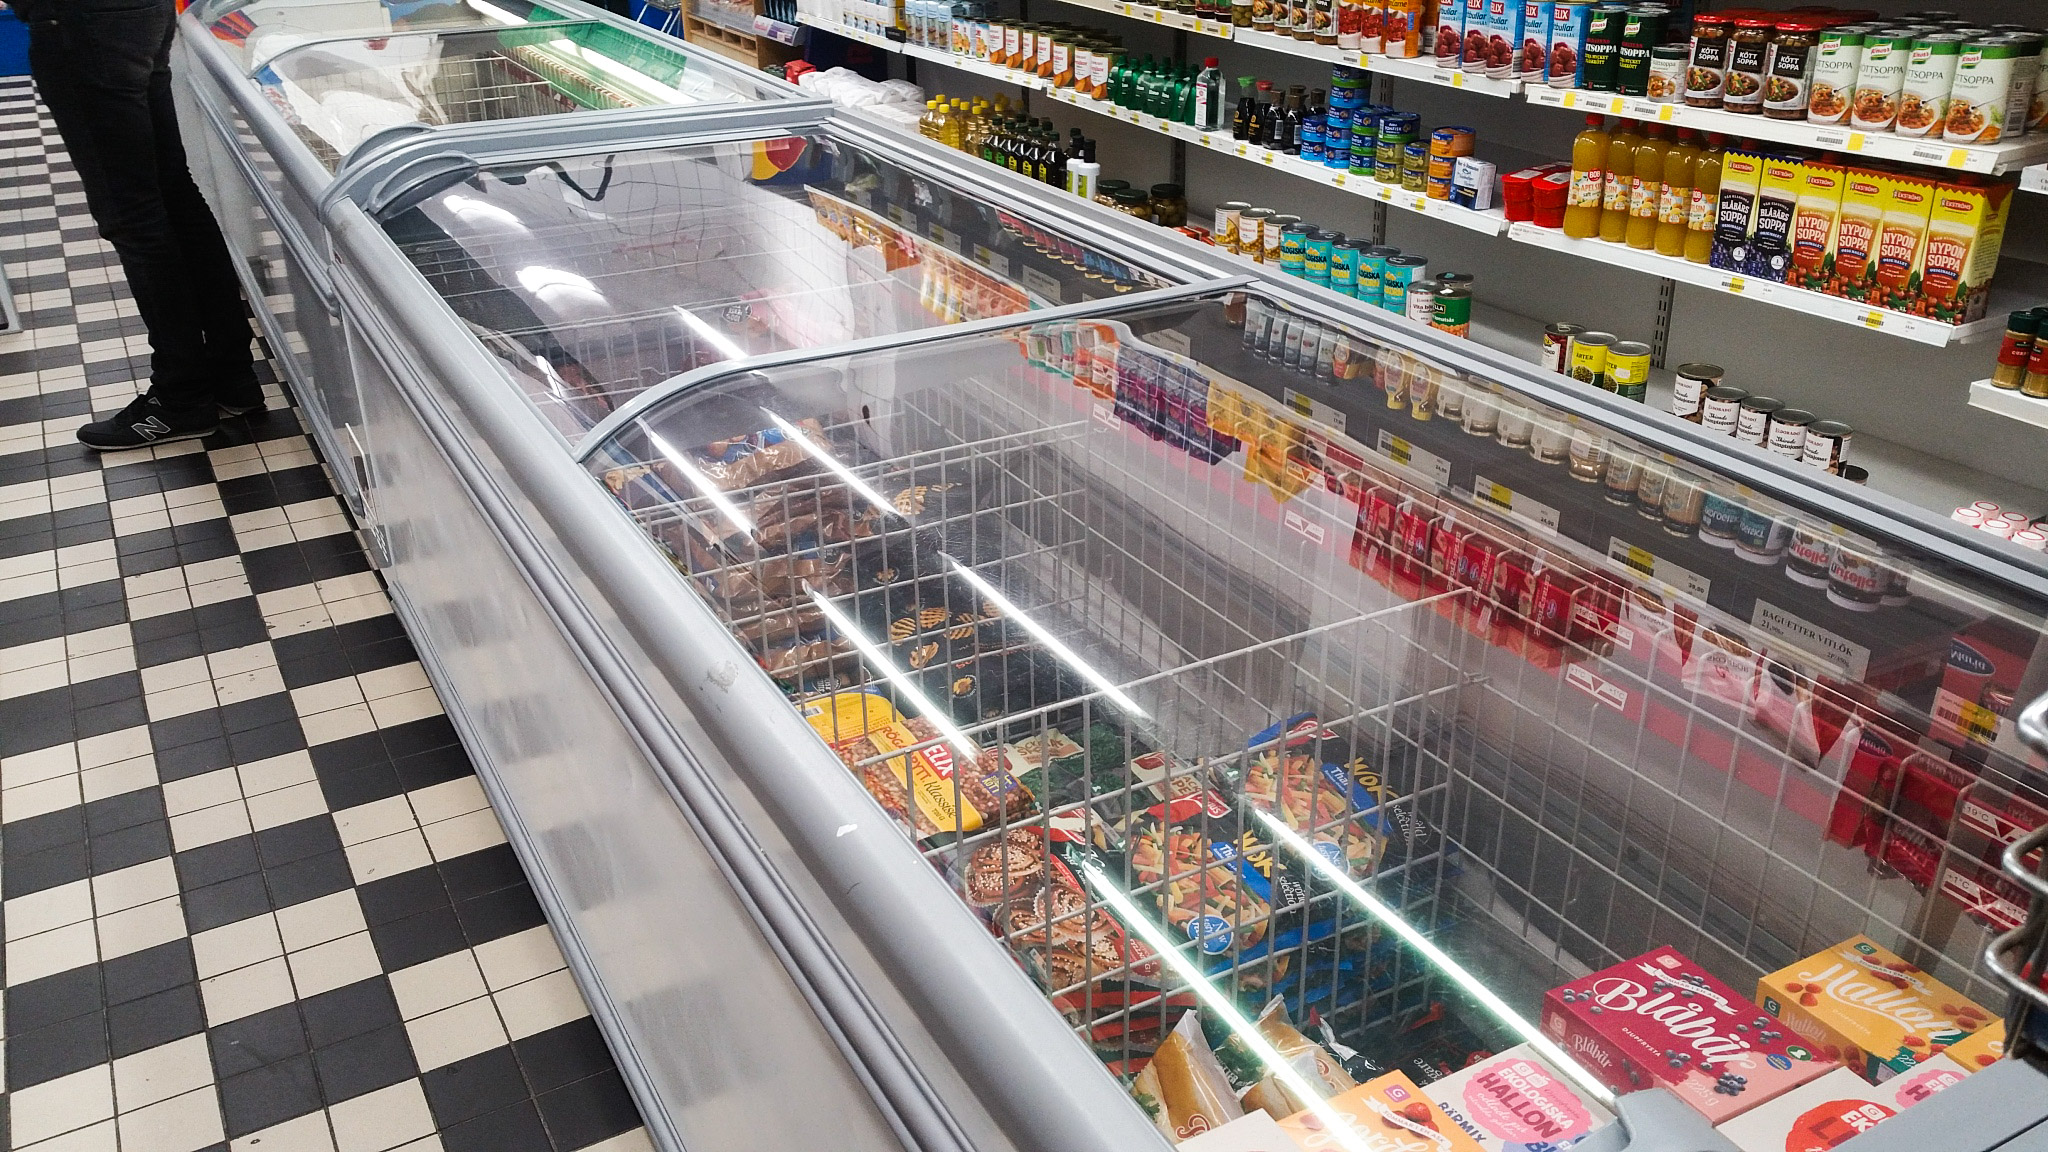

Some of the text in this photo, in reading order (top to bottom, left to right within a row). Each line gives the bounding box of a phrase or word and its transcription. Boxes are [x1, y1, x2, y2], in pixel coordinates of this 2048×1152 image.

[1698, 54, 1719, 62] SOPPA
[1701, 47, 1719, 55] KÖTT
[1739, 51, 1758, 60] KÖTT
[1736, 57, 1758, 66] SOPPA
[1778, 62, 1799, 71] SOPPA
[1780, 55, 1799, 64] KÖTT
[1732, 161, 1754, 171] EKSTRÖMS
[1771, 169, 1793, 178] EKSTRÖMS
[1811, 177, 1834, 187] EKSTRÖMS
[1854, 184, 1878, 193] EKSTRÖMS
[1897, 191, 1922, 201] EKSTRÖMS
[1721, 200, 1750, 214] BLÅBÄRS
[1945, 201, 1972, 211] EKSTRÖMS
[1720, 211, 1747, 226] SOPPA
[1760, 207, 1790, 222] BLÅBÄRS
[1758, 218, 1786, 234] SOPPA
[1798, 216, 1830, 232] NYPON
[1840, 223, 1874, 240] NYPON
[1796, 228, 1826, 244] SOPPA
[1839, 235, 1869, 252] SOPPA
[1883, 232, 1917, 250] NYPON
[1881, 244, 1913, 262] SOPPA
[1929, 242, 1966, 260] NYPON
[1927, 254, 1961, 272] SOPPA
[1708, 404, 1732, 413] ELDORADO
[1709, 413, 1728, 421] Skivade
[131, 415, 171, 441] N
[1775, 427, 1801, 436] ELDORADO
[1776, 435, 1796, 444] Skivade
[1762, 608, 1853, 657] BAGUETTER VITLÖK
[1797, 962, 1962, 1041] Hallon
[1592, 977, 1757, 1070] Blåbär
[1621, 1026, 1662, 1058] DJUPFRYSTA
[1572, 1033, 1613, 1069] Blåbär
[1476, 1072, 1562, 1138] HALLON
[1500, 1068, 1574, 1129] EKOLOGISKA
[1437, 1101, 1487, 1143] BÄRMIX
